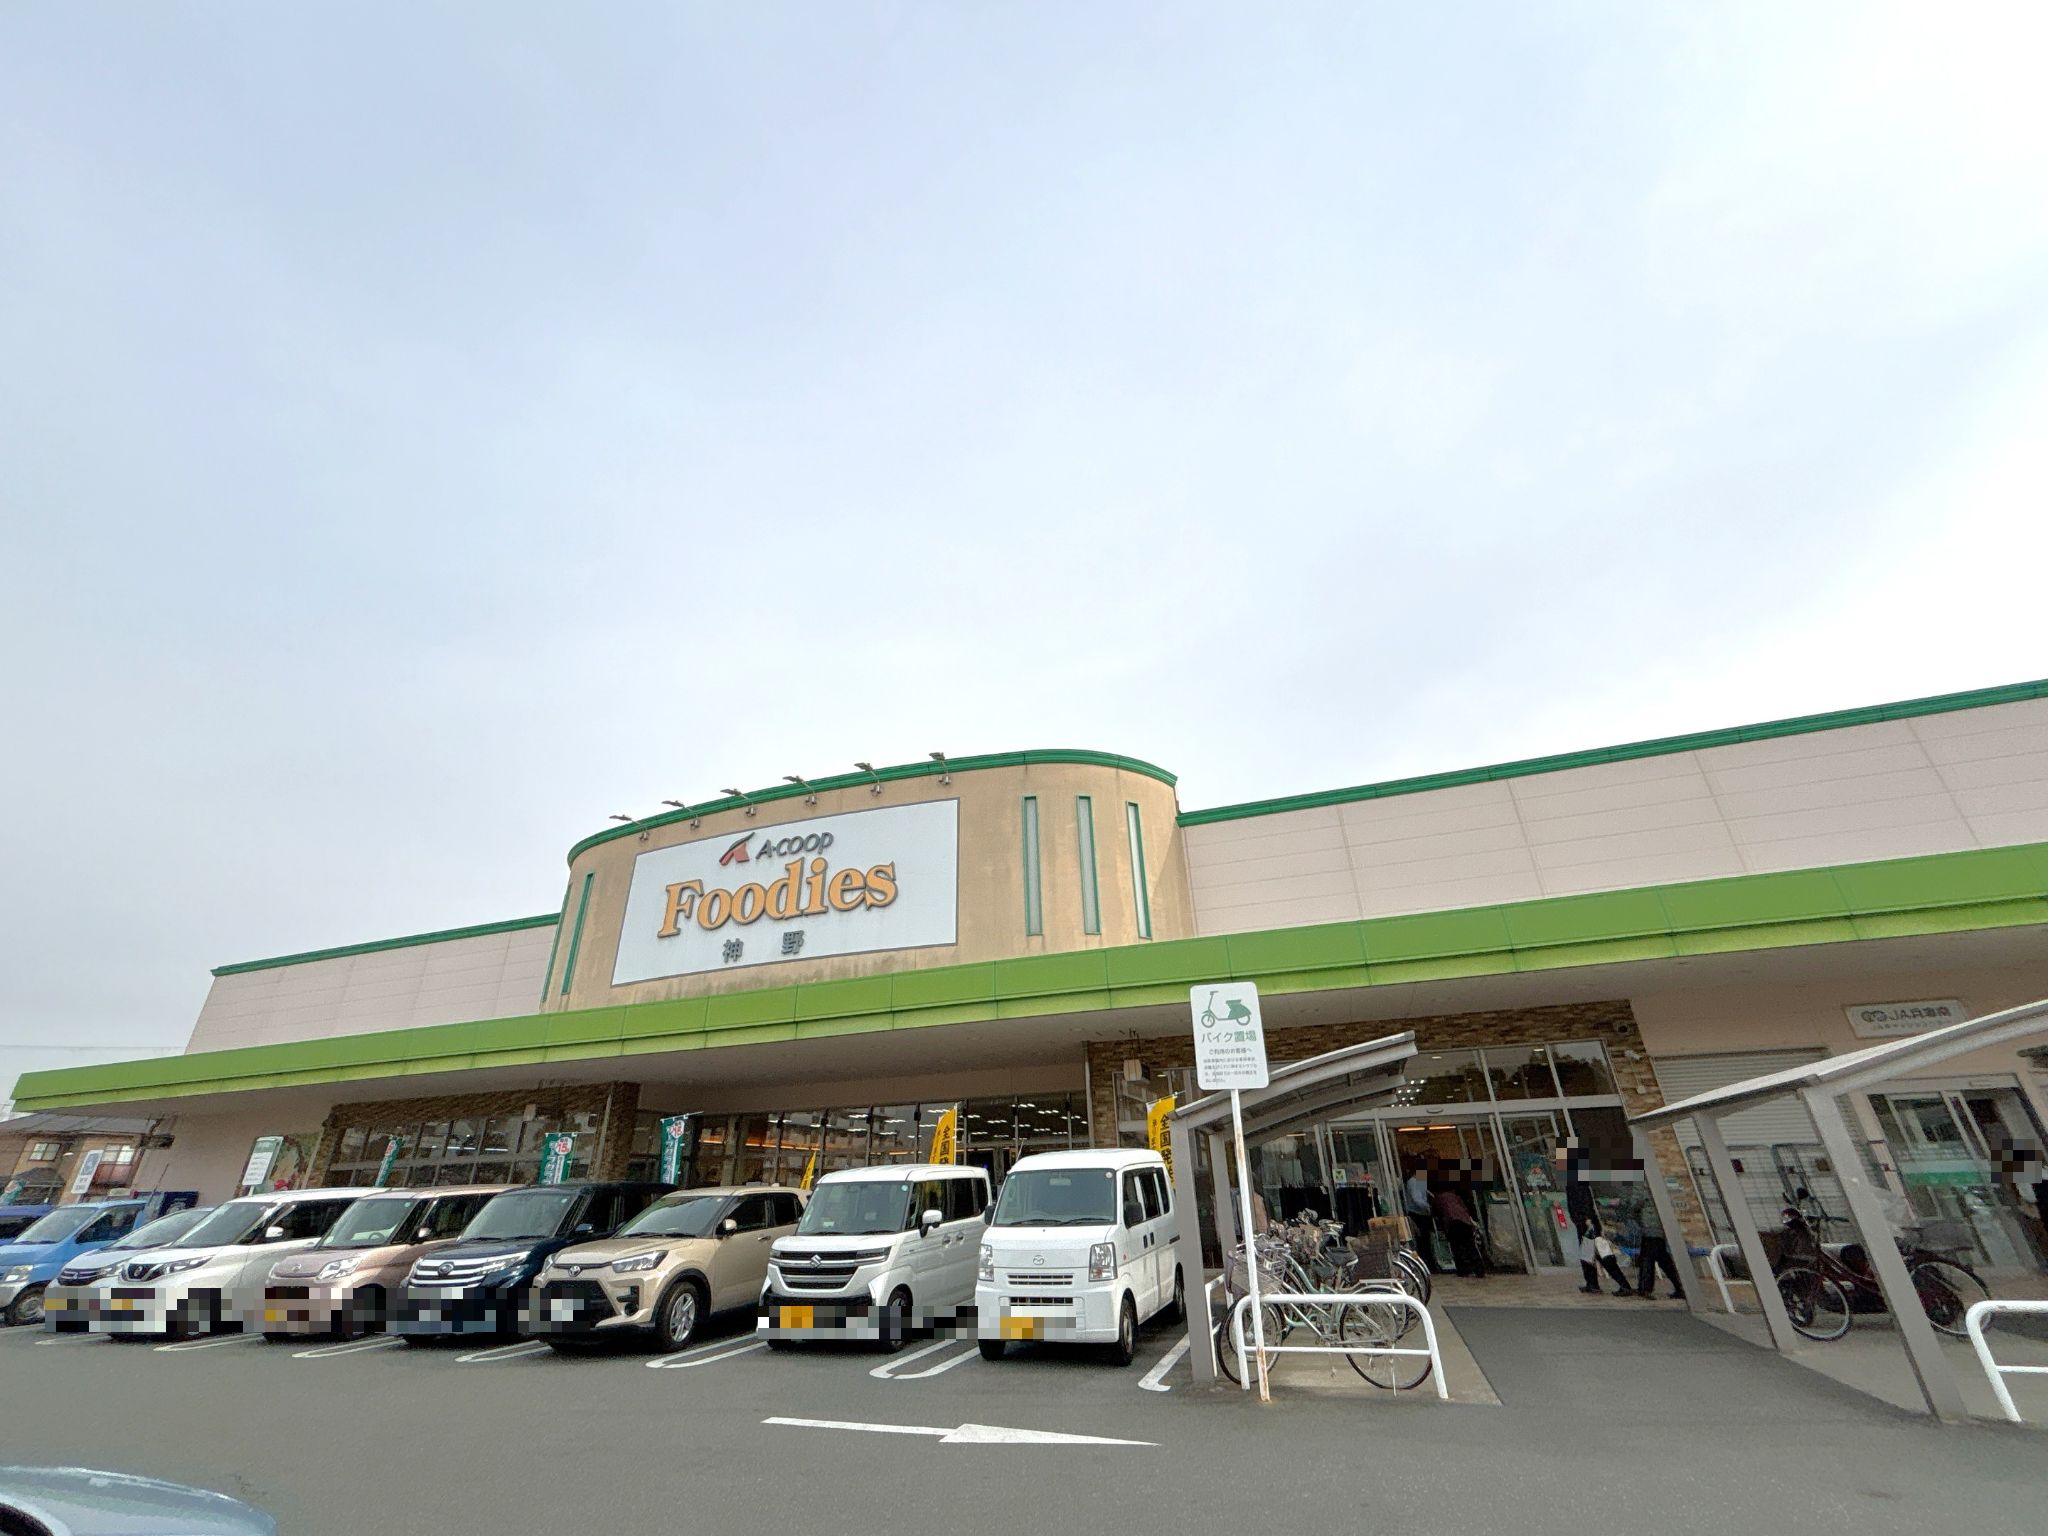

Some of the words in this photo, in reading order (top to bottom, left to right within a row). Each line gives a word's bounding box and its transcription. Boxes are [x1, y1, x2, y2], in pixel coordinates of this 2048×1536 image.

[657, 856, 898, 938] Foodies
[1201, 1029, 1257, 1043] バイク置場
